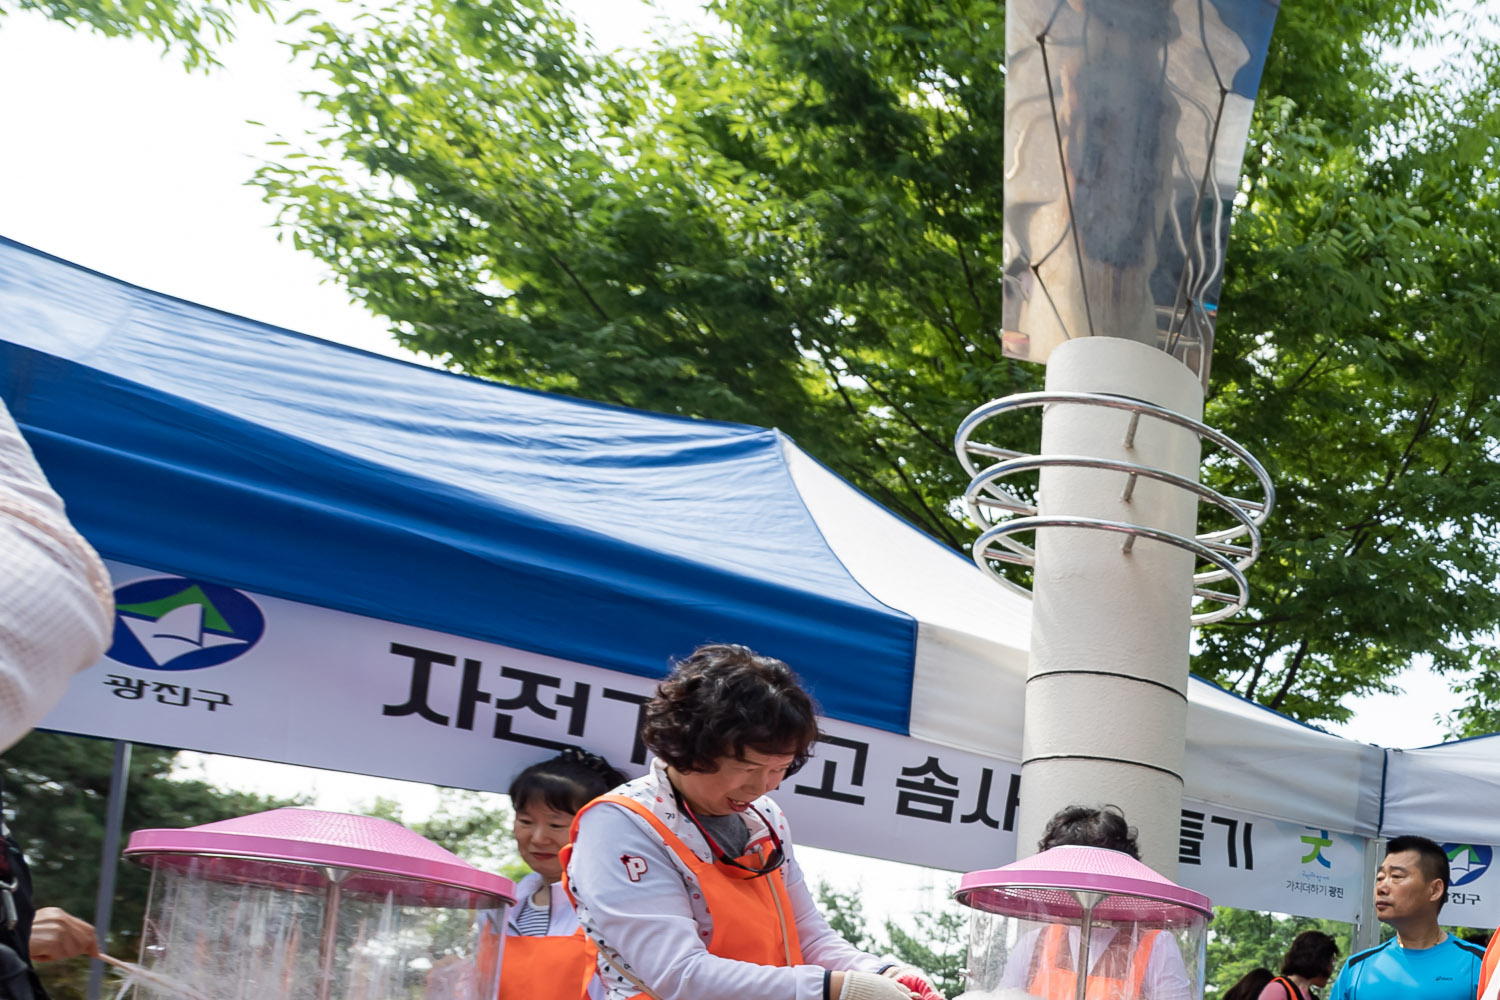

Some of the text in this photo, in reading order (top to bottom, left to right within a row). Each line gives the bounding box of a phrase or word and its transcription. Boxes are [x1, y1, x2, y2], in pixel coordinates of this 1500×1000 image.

[102, 673, 233, 712] 광진구
[775, 732, 869, 806] 고
[625, 855, 649, 882] P
[1286, 880, 1344, 899] 가치더하기 광진
[1446, 892, 1481, 905] 진구
